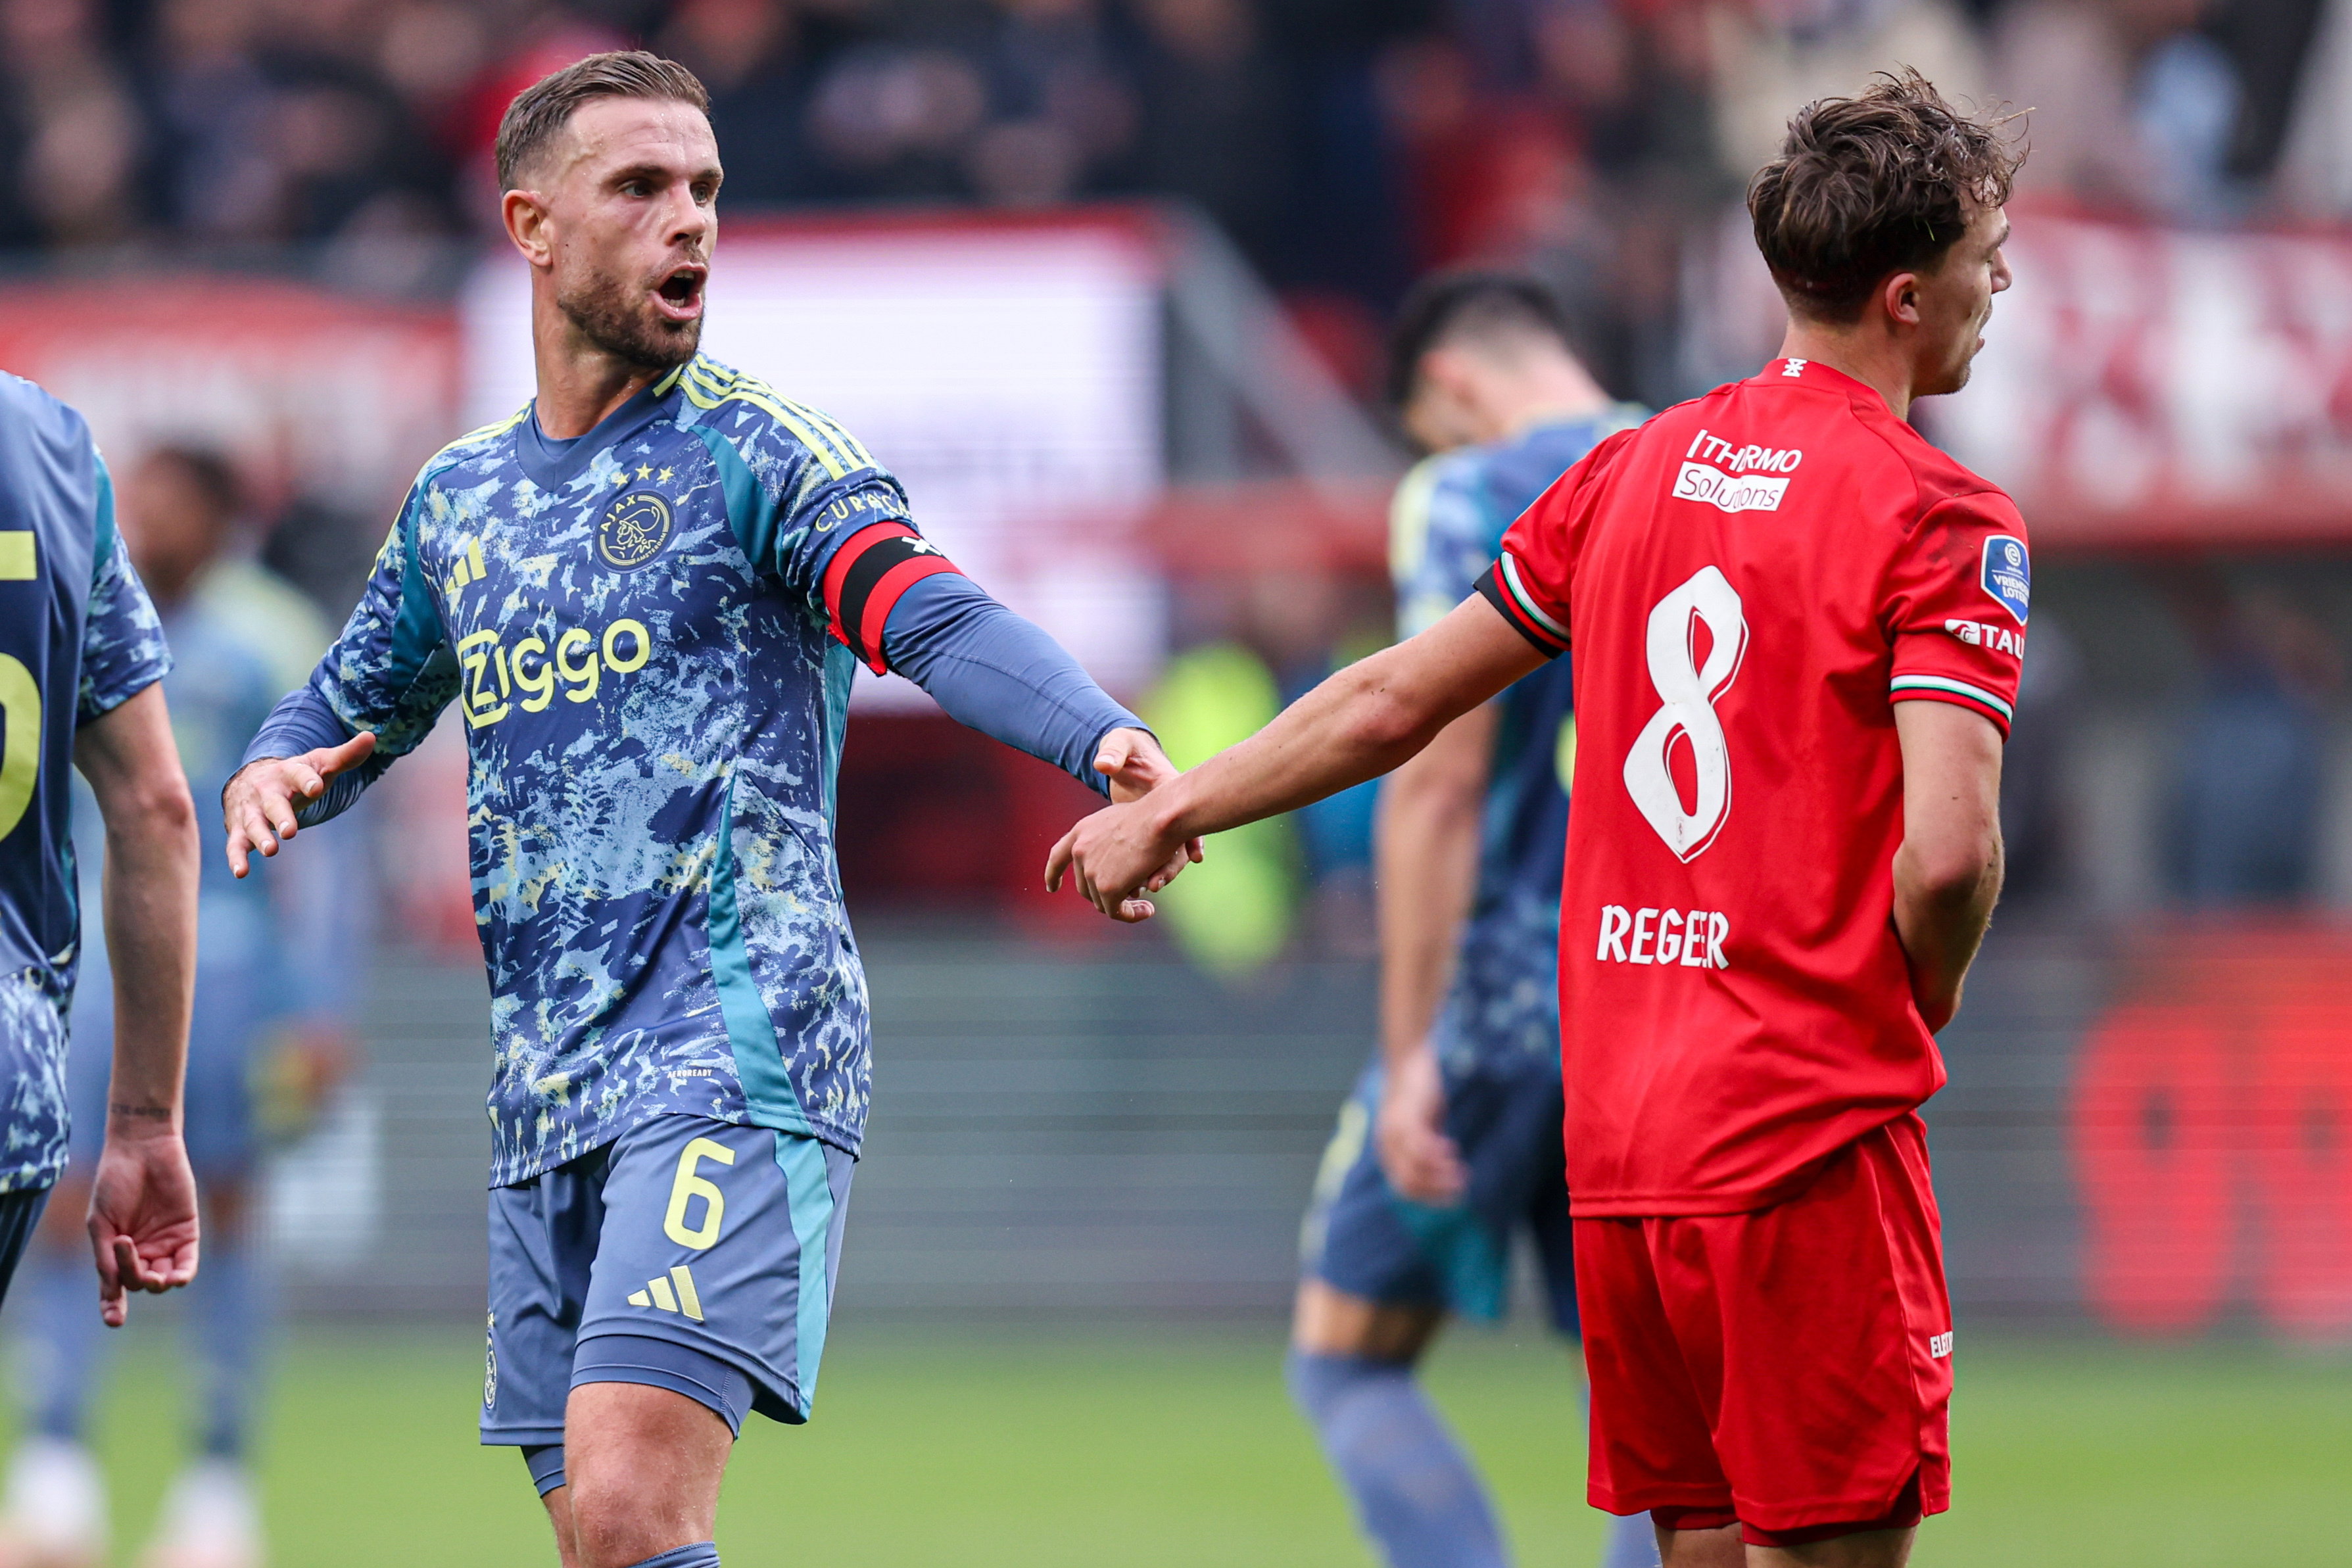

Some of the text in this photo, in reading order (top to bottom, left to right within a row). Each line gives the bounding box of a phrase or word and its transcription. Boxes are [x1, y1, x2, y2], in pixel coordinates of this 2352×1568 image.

[600, 494, 636, 532] AJAX
[1623, 565, 1749, 864] 8
[1596, 904, 1729, 970] REGER
[667, 1069, 712, 1078] AEROREADY
[663, 1137, 736, 1250] 6
